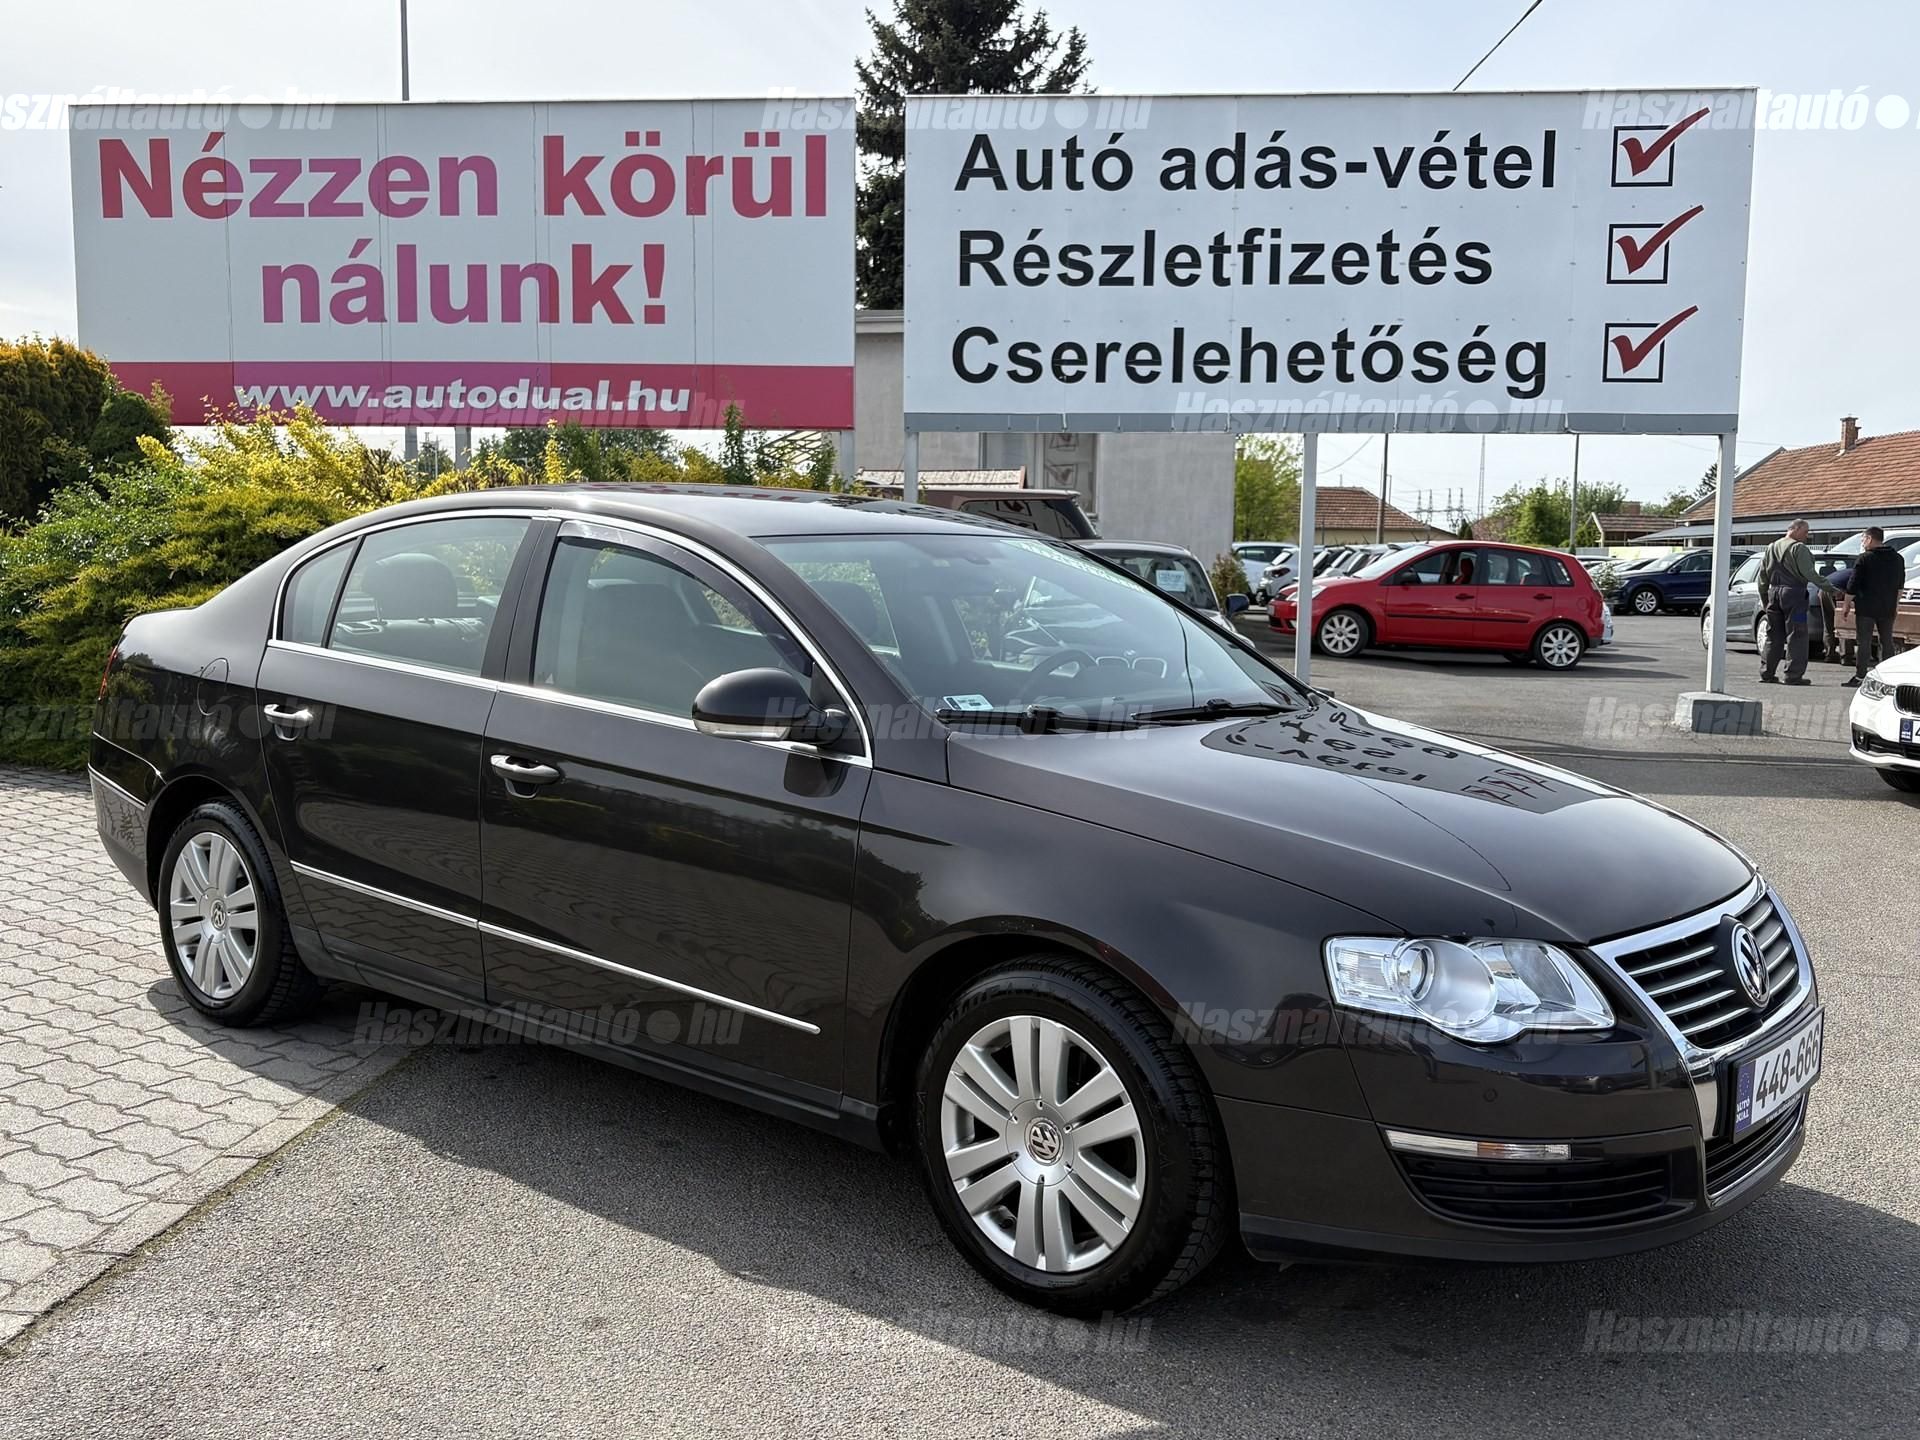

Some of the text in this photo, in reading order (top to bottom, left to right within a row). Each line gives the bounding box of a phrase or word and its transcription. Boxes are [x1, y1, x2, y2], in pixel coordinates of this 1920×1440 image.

[100, 132, 825, 218] Nézzen körül
[955, 130, 1555, 191] Autó adás-vétel
[264, 241, 664, 323] nálunk!
[960, 227, 1491, 286] Részletfizetés
[234, 378, 690, 412] www.autodual.hu
[953, 325, 1545, 399] Cserelehetőség
[1756, 1024, 1820, 1108] 448-666
